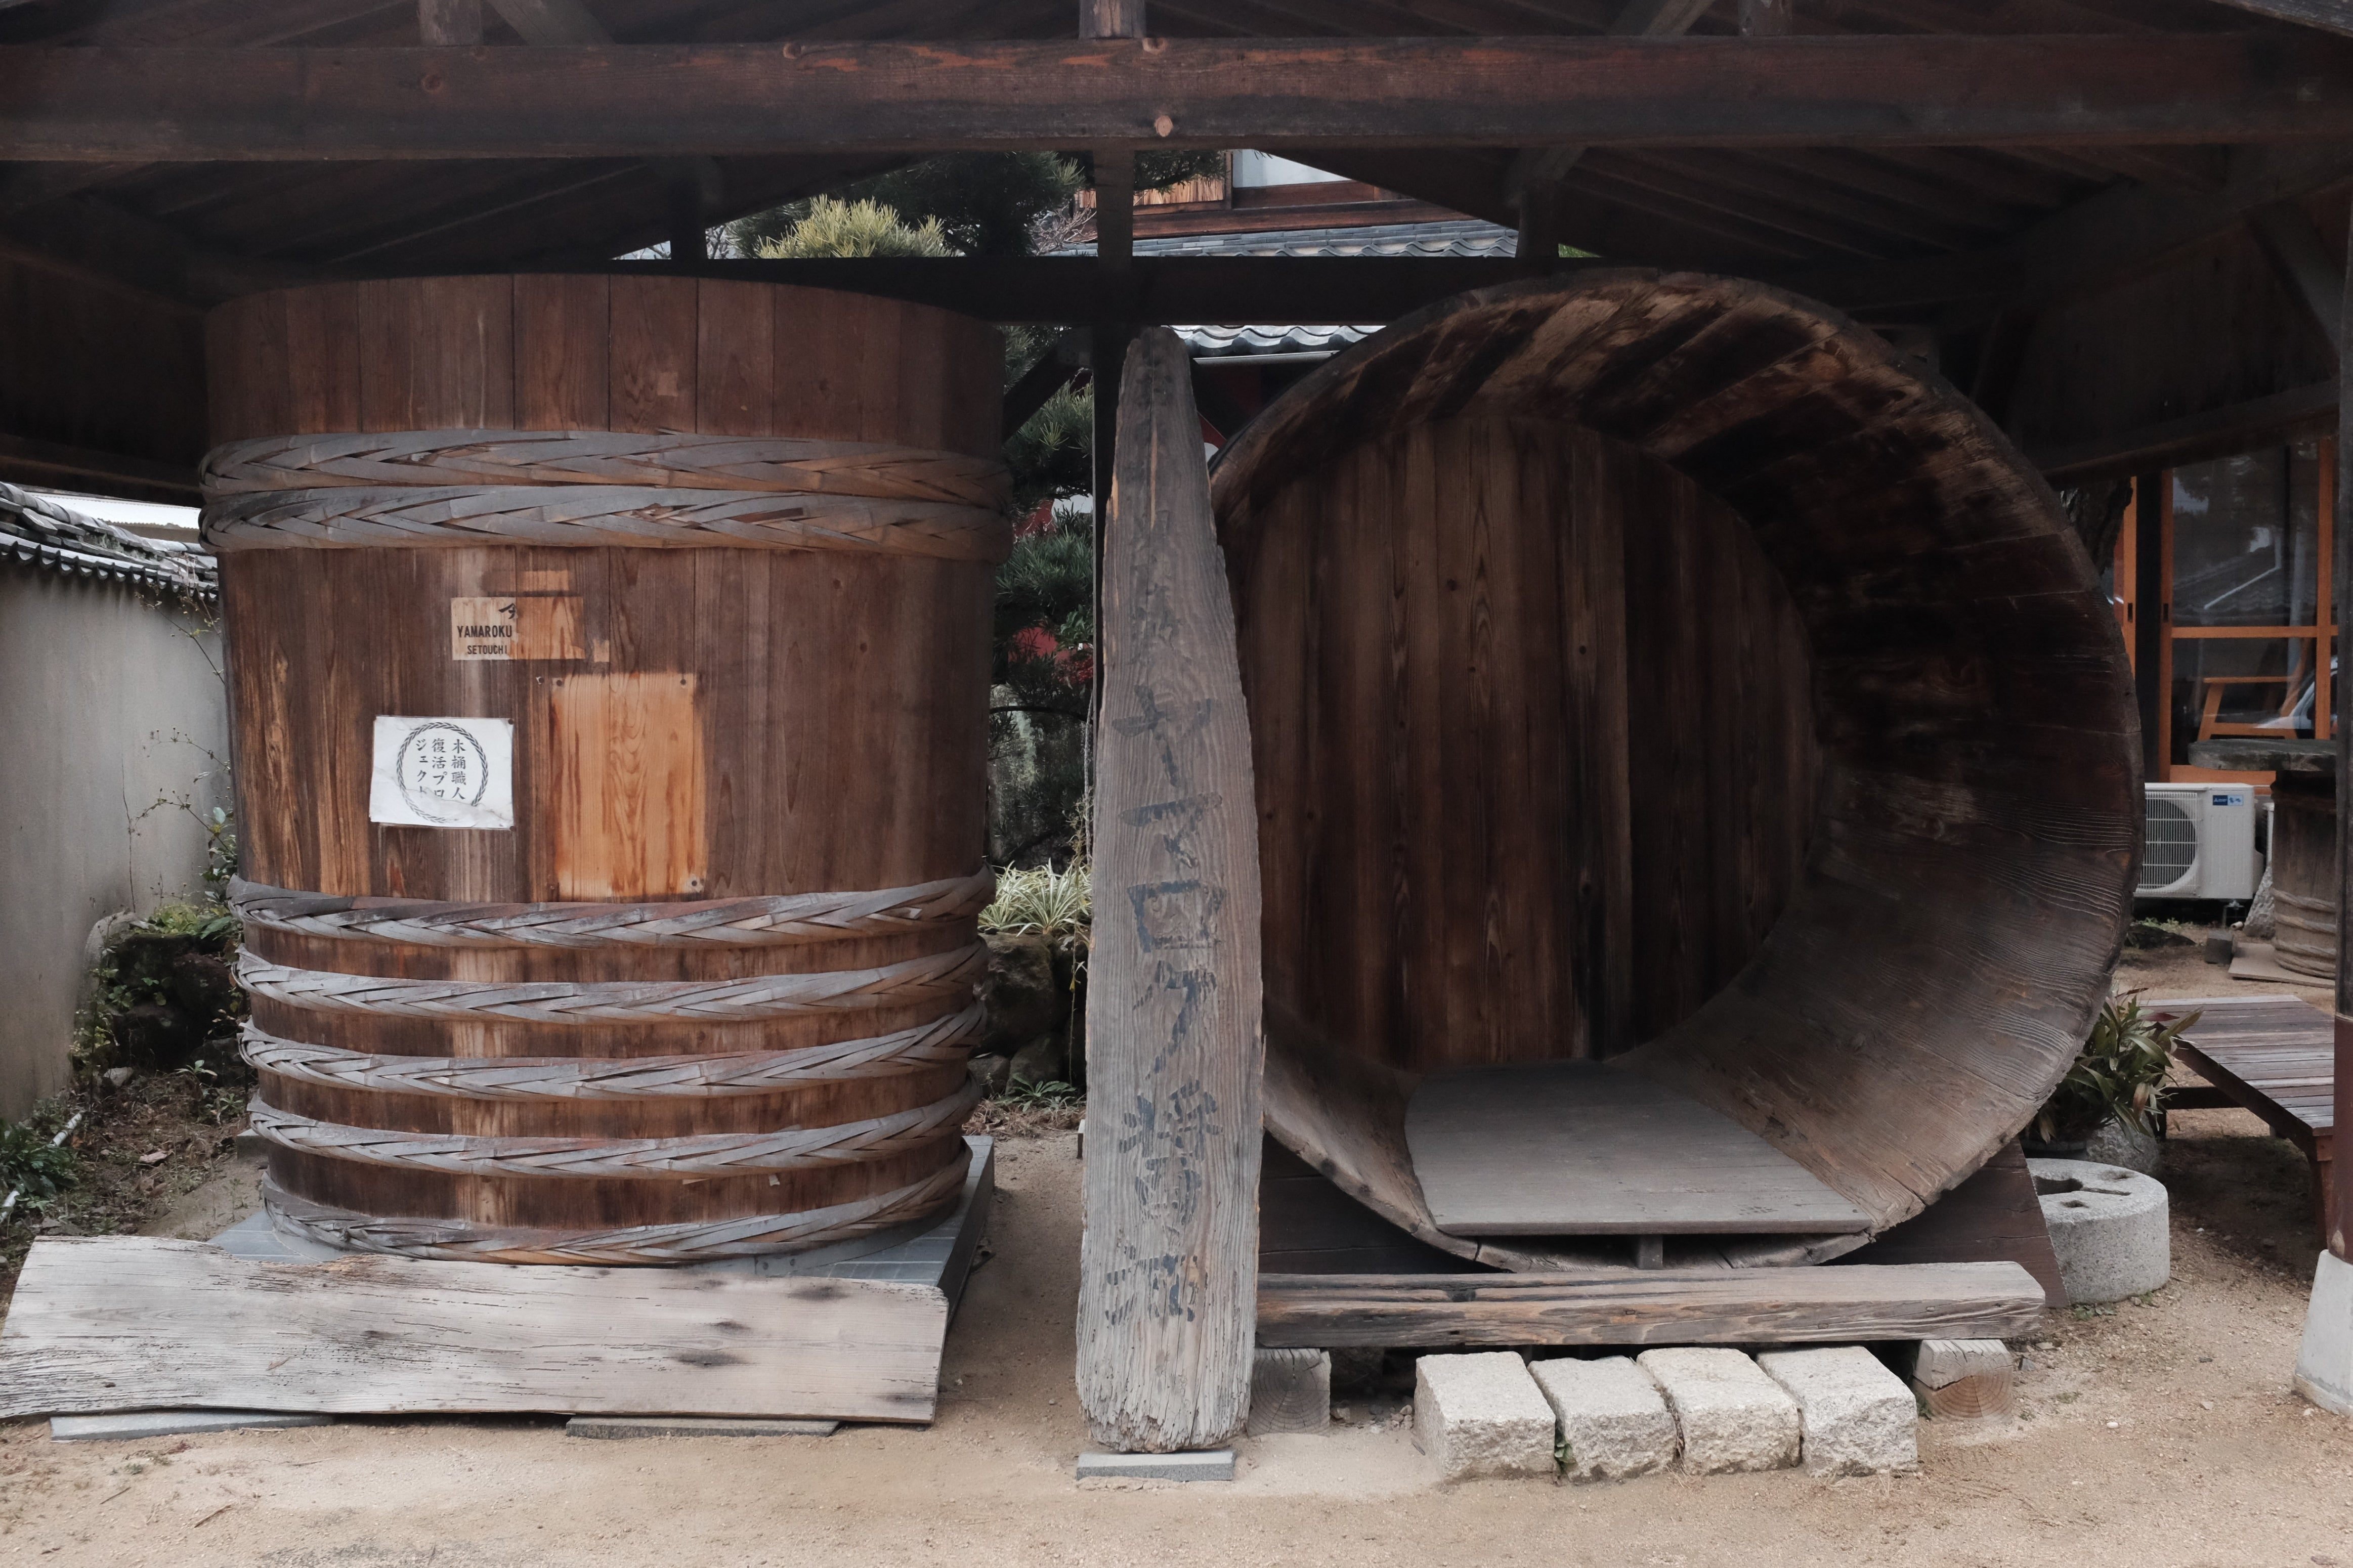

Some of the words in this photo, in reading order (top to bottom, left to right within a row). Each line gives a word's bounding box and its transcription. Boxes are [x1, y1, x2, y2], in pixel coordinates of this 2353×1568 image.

[457, 625, 512, 638] YAMAROKU
[467, 645, 507, 655] SETOUCHI
[415, 738, 429, 798] ジェクト
[432, 737, 448, 798] 復活プロ
[451, 738, 466, 800] 木桶職人
